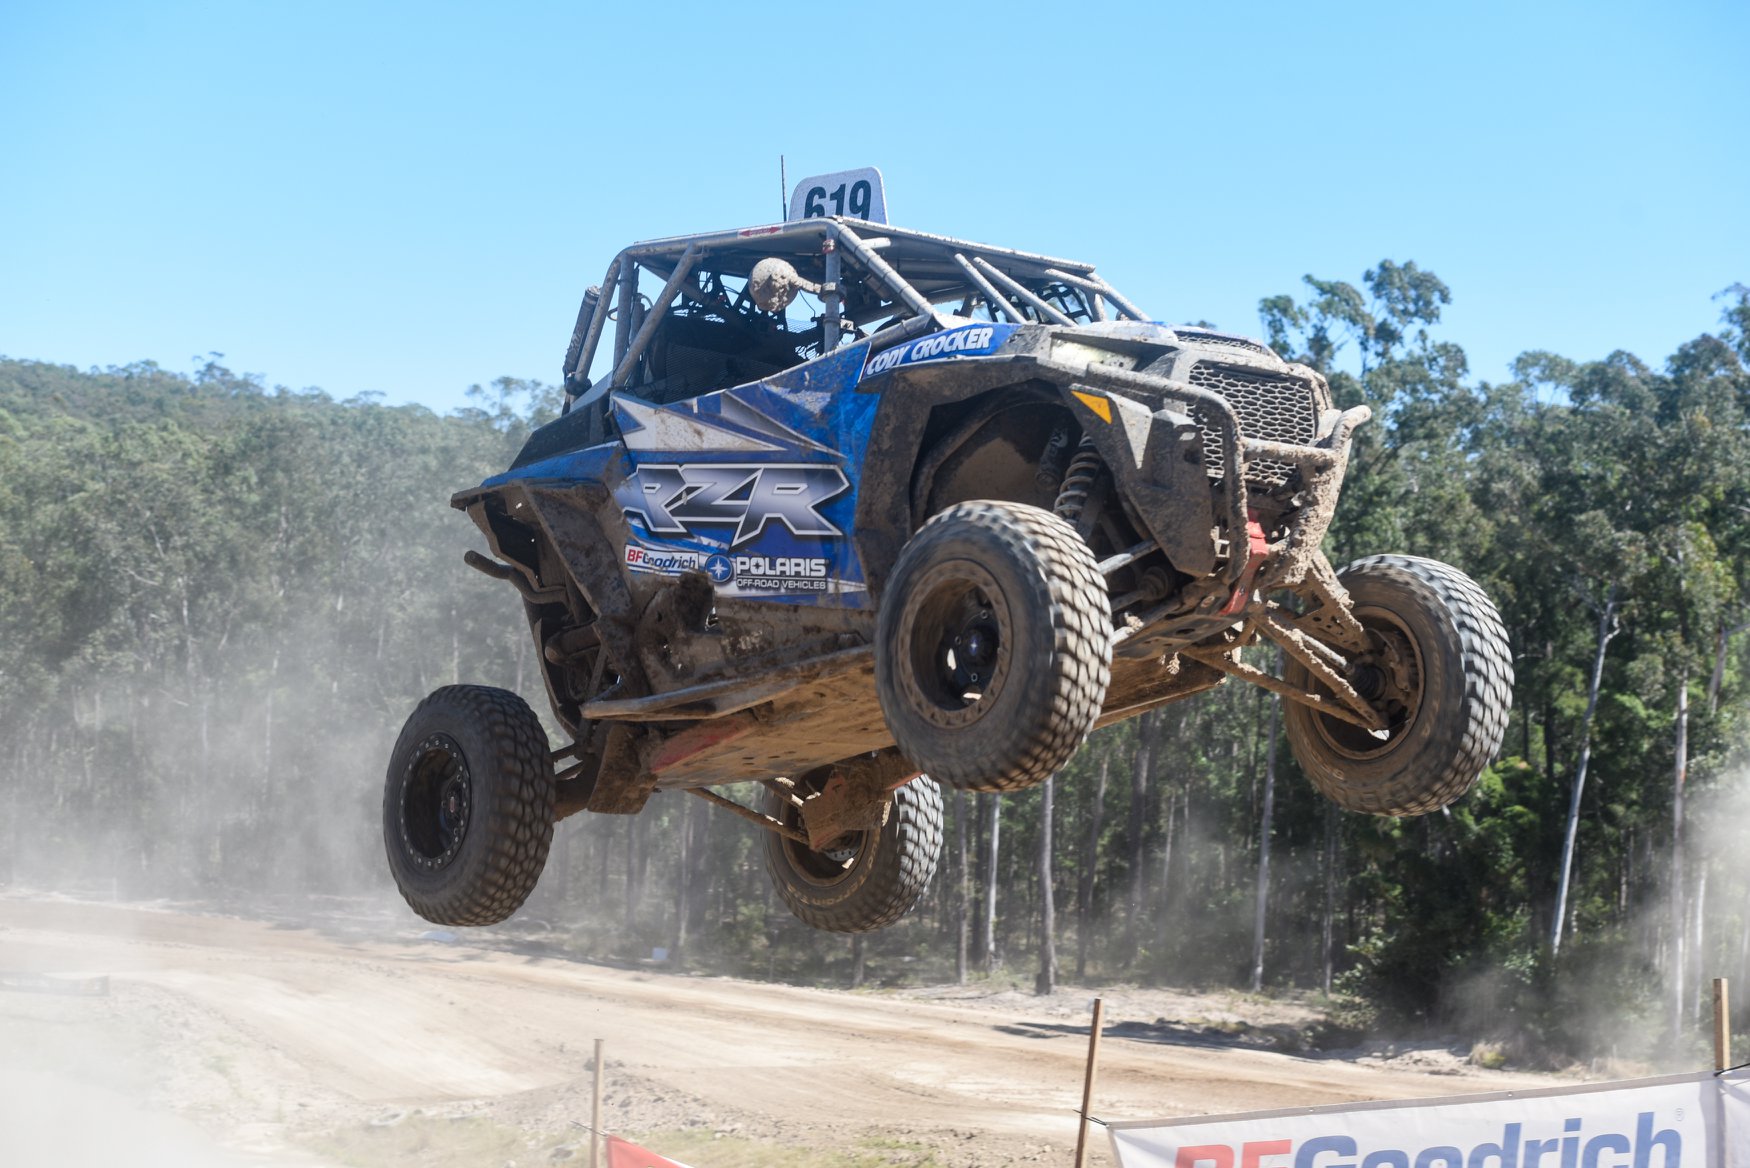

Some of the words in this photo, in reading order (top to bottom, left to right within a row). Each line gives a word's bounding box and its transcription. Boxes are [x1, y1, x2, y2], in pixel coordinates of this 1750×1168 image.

[804, 180, 872, 221] 619
[867, 345, 910, 375] CODY
[911, 327, 994, 362] CROCKER
[614, 463, 850, 550] RZR
[736, 556, 826, 577] POLARIS
[737, 579, 780, 588] OFF-ROAD
[782, 580, 826, 590] VEHICLES
